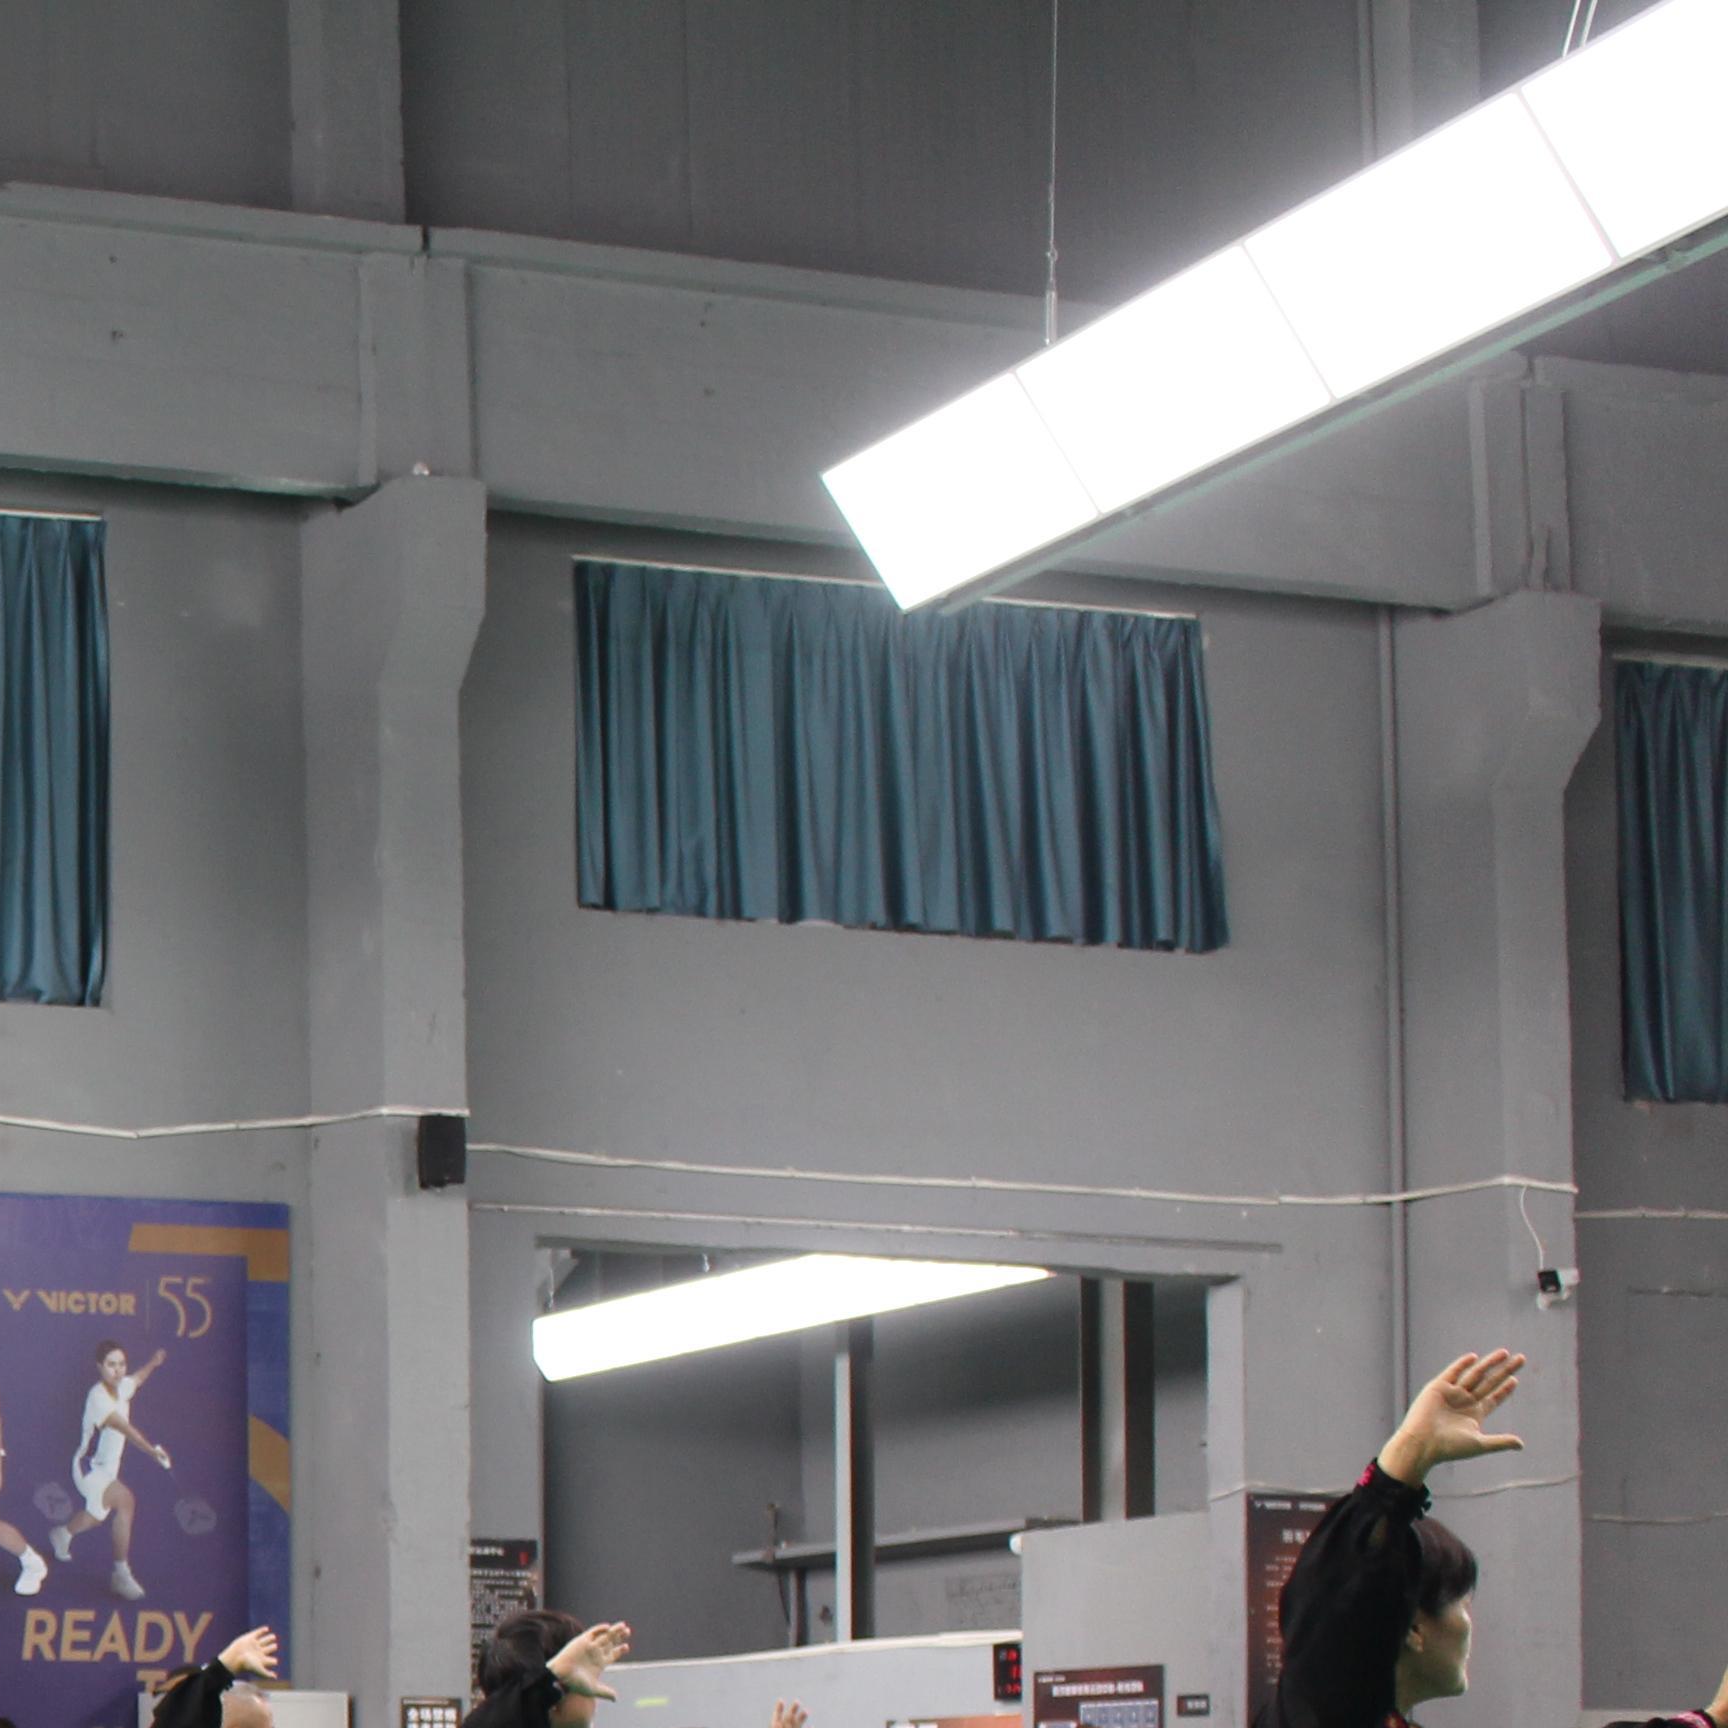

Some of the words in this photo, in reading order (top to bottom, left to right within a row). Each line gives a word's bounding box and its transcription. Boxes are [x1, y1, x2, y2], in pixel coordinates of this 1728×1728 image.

[37, 1290, 137, 1316] VICTOR
[158, 1275, 214, 1339] 55
[22, 1609, 213, 1664] READY
